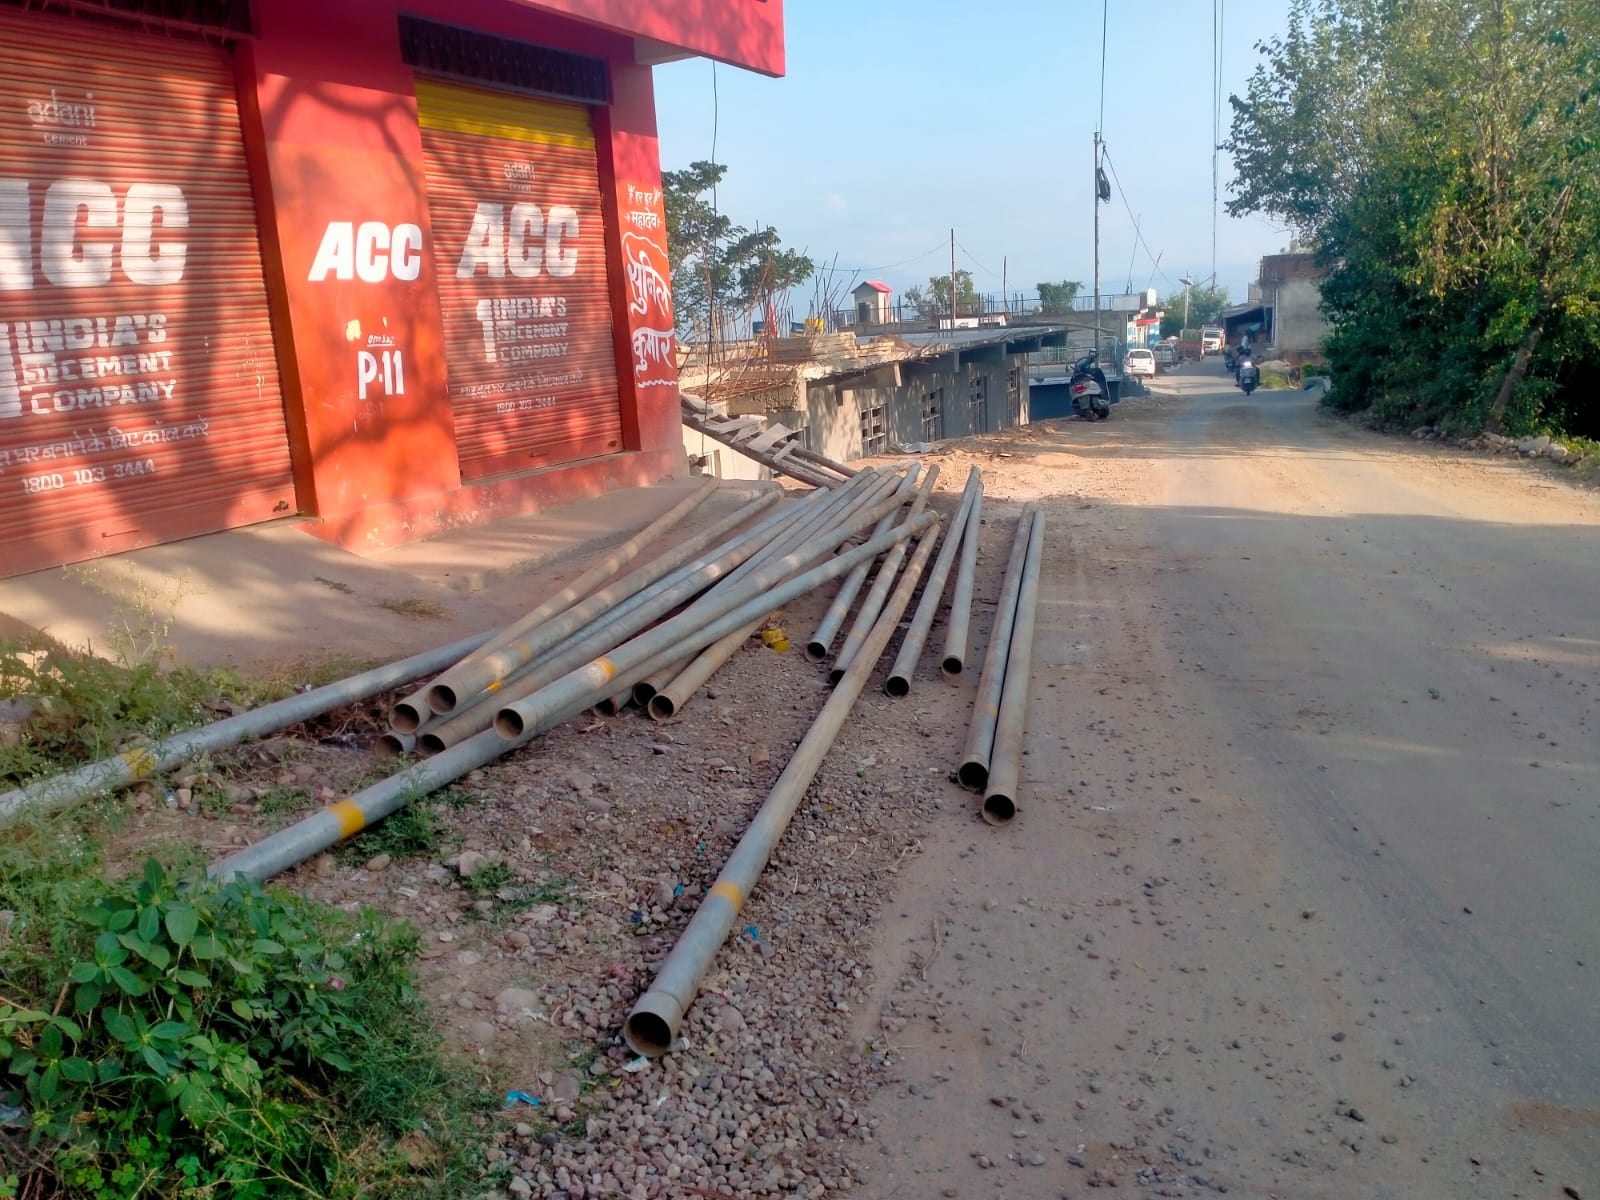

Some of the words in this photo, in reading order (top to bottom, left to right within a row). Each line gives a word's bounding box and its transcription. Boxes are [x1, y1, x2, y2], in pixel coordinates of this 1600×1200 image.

[27, 89, 95, 127] adani
[503, 161, 536, 180] adani
[631, 207, 658, 230] महादेव
[307, 221, 423, 283] ACC
[456, 202, 580, 278] ACC
[494, 297, 567, 319] INDIA'S
[15, 314, 168, 353] INDIA'S
[516, 323, 569, 339] CEMENT
[61, 351, 174, 381] CEMENT
[500, 343, 569, 362] COMPANY
[632, 327, 675, 378] कुमार
[31, 380, 177, 414] COMPANY
[14, 447, 39, 462] घर
[22, 473, 65, 494] 1800
[74, 467, 106, 486] 103
